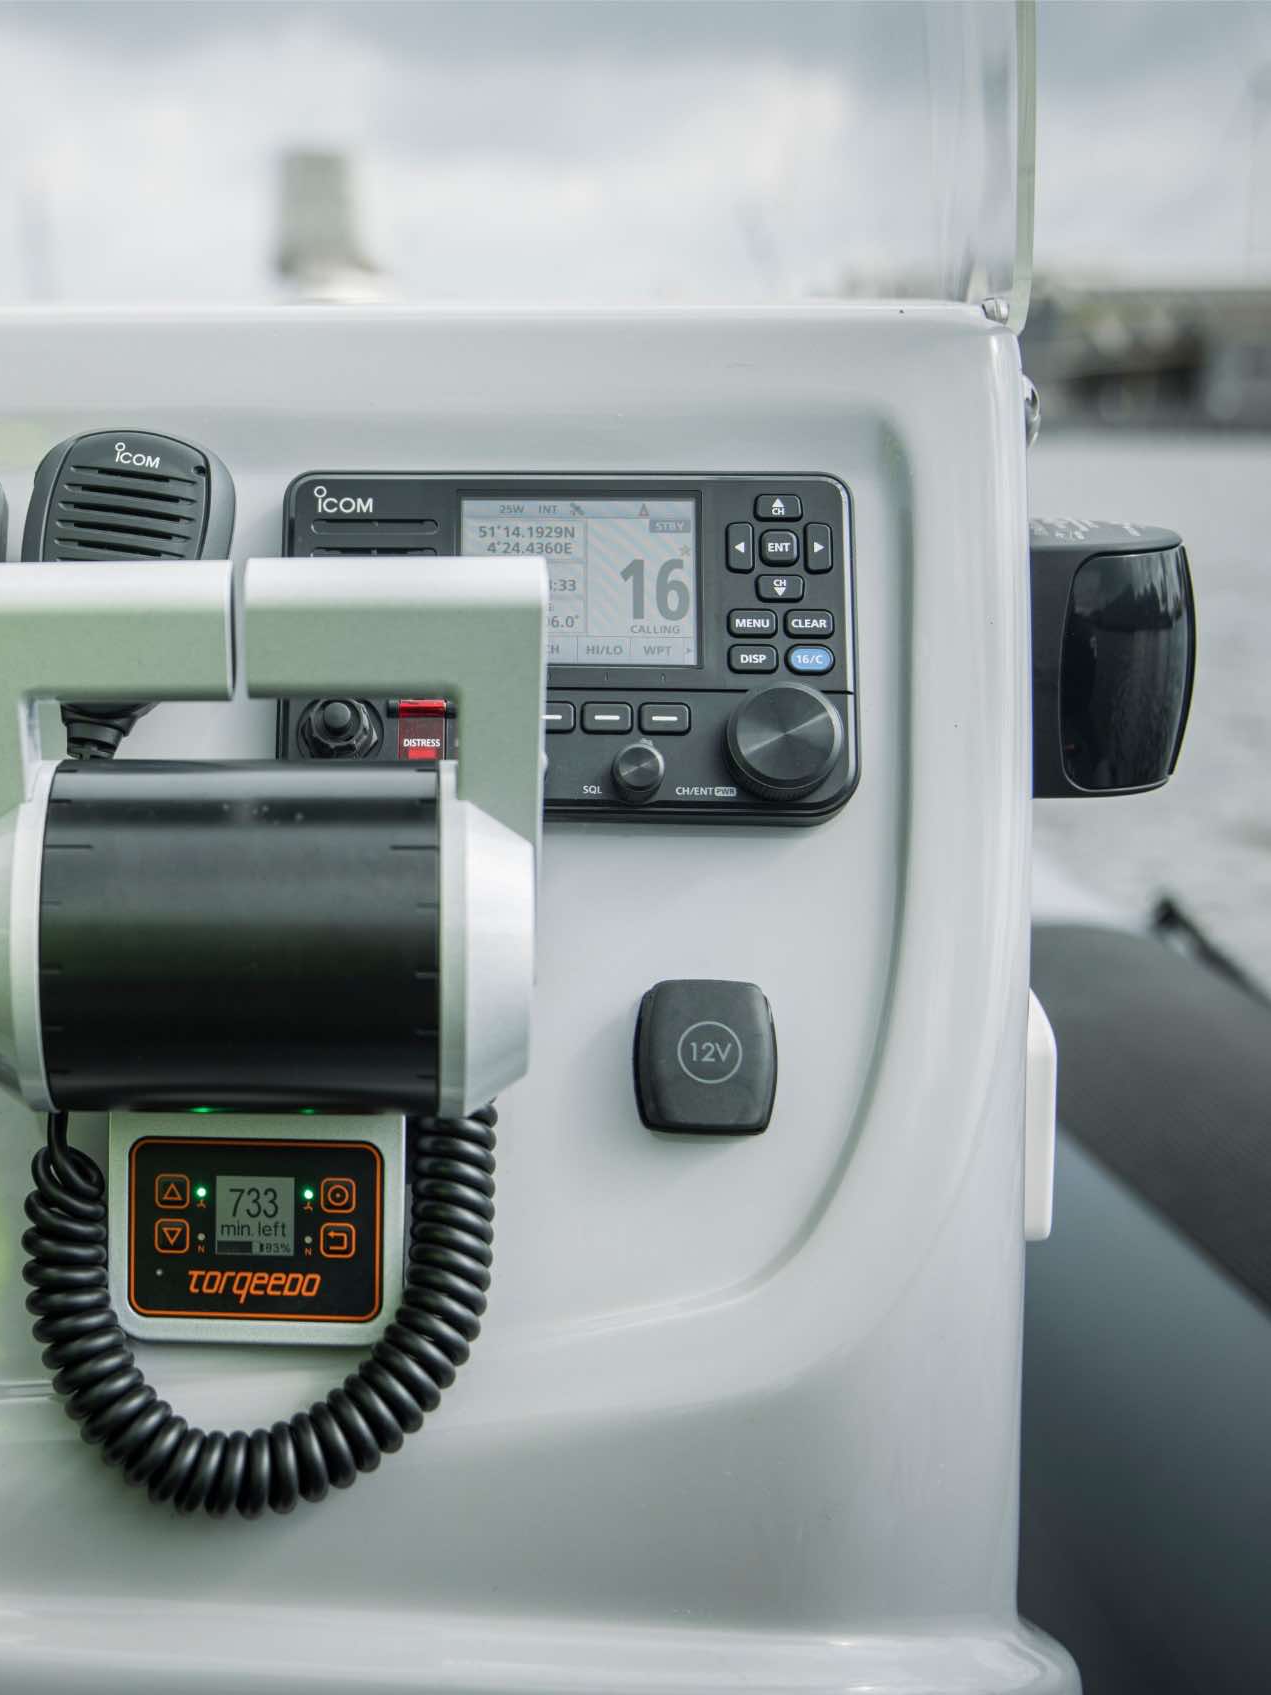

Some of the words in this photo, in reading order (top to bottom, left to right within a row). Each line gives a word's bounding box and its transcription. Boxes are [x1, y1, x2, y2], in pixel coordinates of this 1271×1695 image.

[538, 505, 558, 514] INT
[655, 522, 684, 531] STBY
[767, 542, 791, 552] ENT
[773, 579, 787, 587] CH
[619, 558, 690, 621] 16
[735, 618, 770, 628] MENU
[791, 618, 827, 628] CLEAR
[630, 625, 680, 634] CALLING
[585, 645, 623, 655] HI/LO
[643, 646, 673, 656] WPT
[740, 654, 767, 664] DISP
[796, 654, 823, 664] 16/C
[403, 738, 441, 747] DISTRESS
[582, 785, 602, 794] SQL
[690, 1042, 731, 1062] 12V
[230, 1188, 279, 1218] 733
[220, 1220, 254, 1237] min.
[258, 1221, 286, 1237] left
[304, 1248, 312, 1256] N
